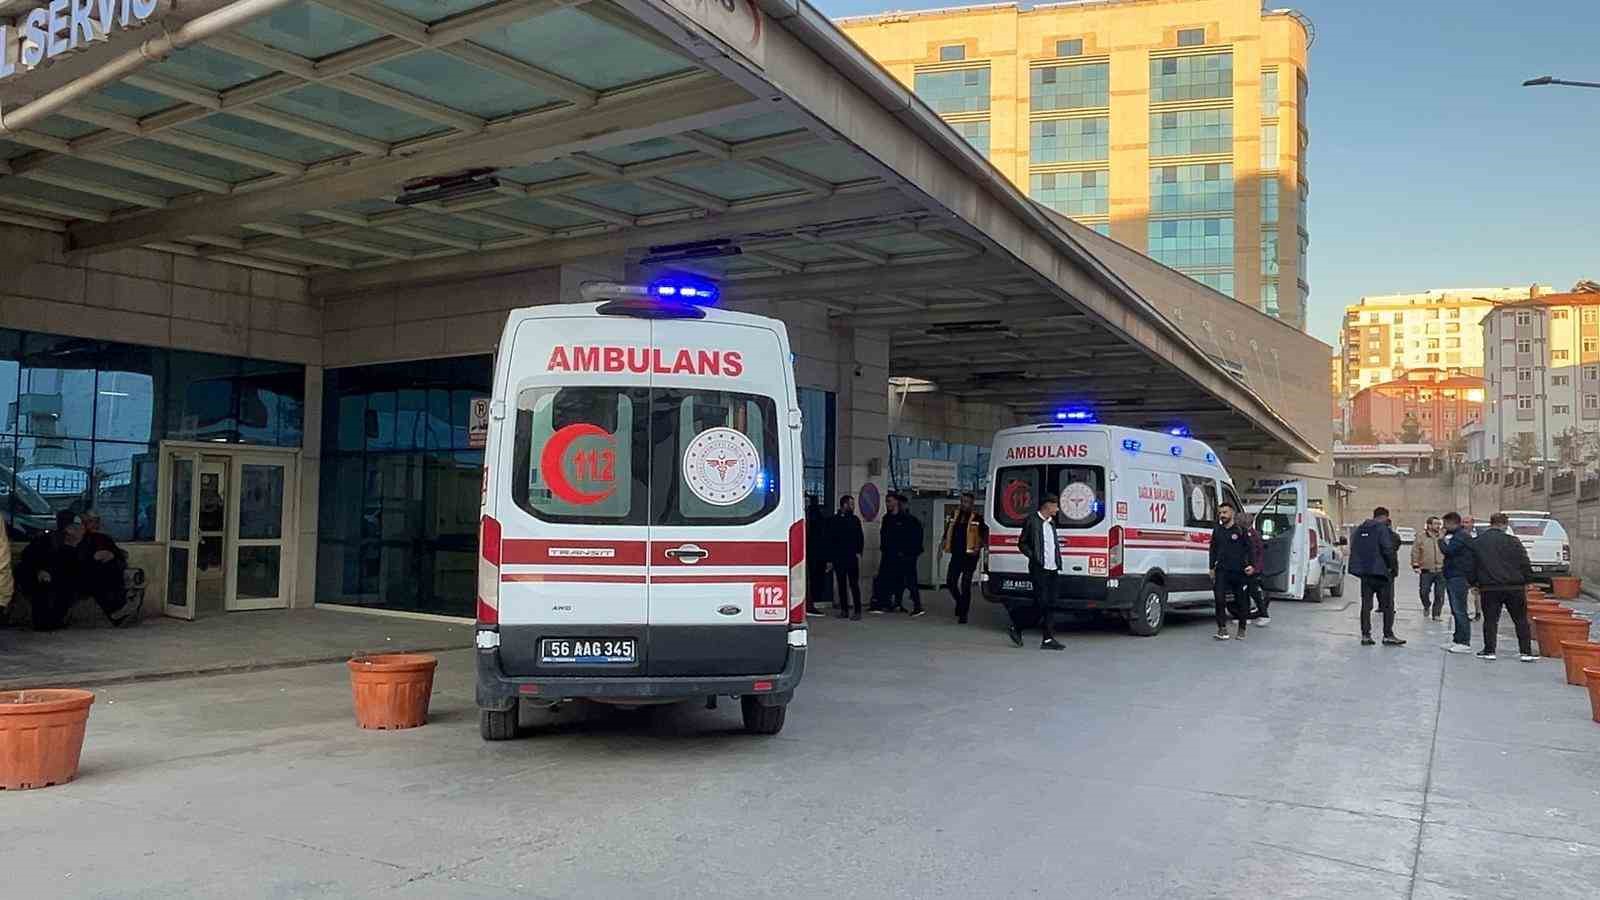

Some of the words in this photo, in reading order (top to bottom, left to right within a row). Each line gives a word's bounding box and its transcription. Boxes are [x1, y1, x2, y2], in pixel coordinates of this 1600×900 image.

[548, 346, 744, 377] AMBULANS
[1006, 444, 1088, 460] AMBULANS
[571, 448, 616, 480] 112
[1149, 502, 1167, 523] 112
[1091, 557, 1105, 567] 112
[757, 586, 784, 606] 112
[552, 642, 569, 656] 56
[574, 642, 601, 656] AAG
[604, 642, 631, 656] 345
